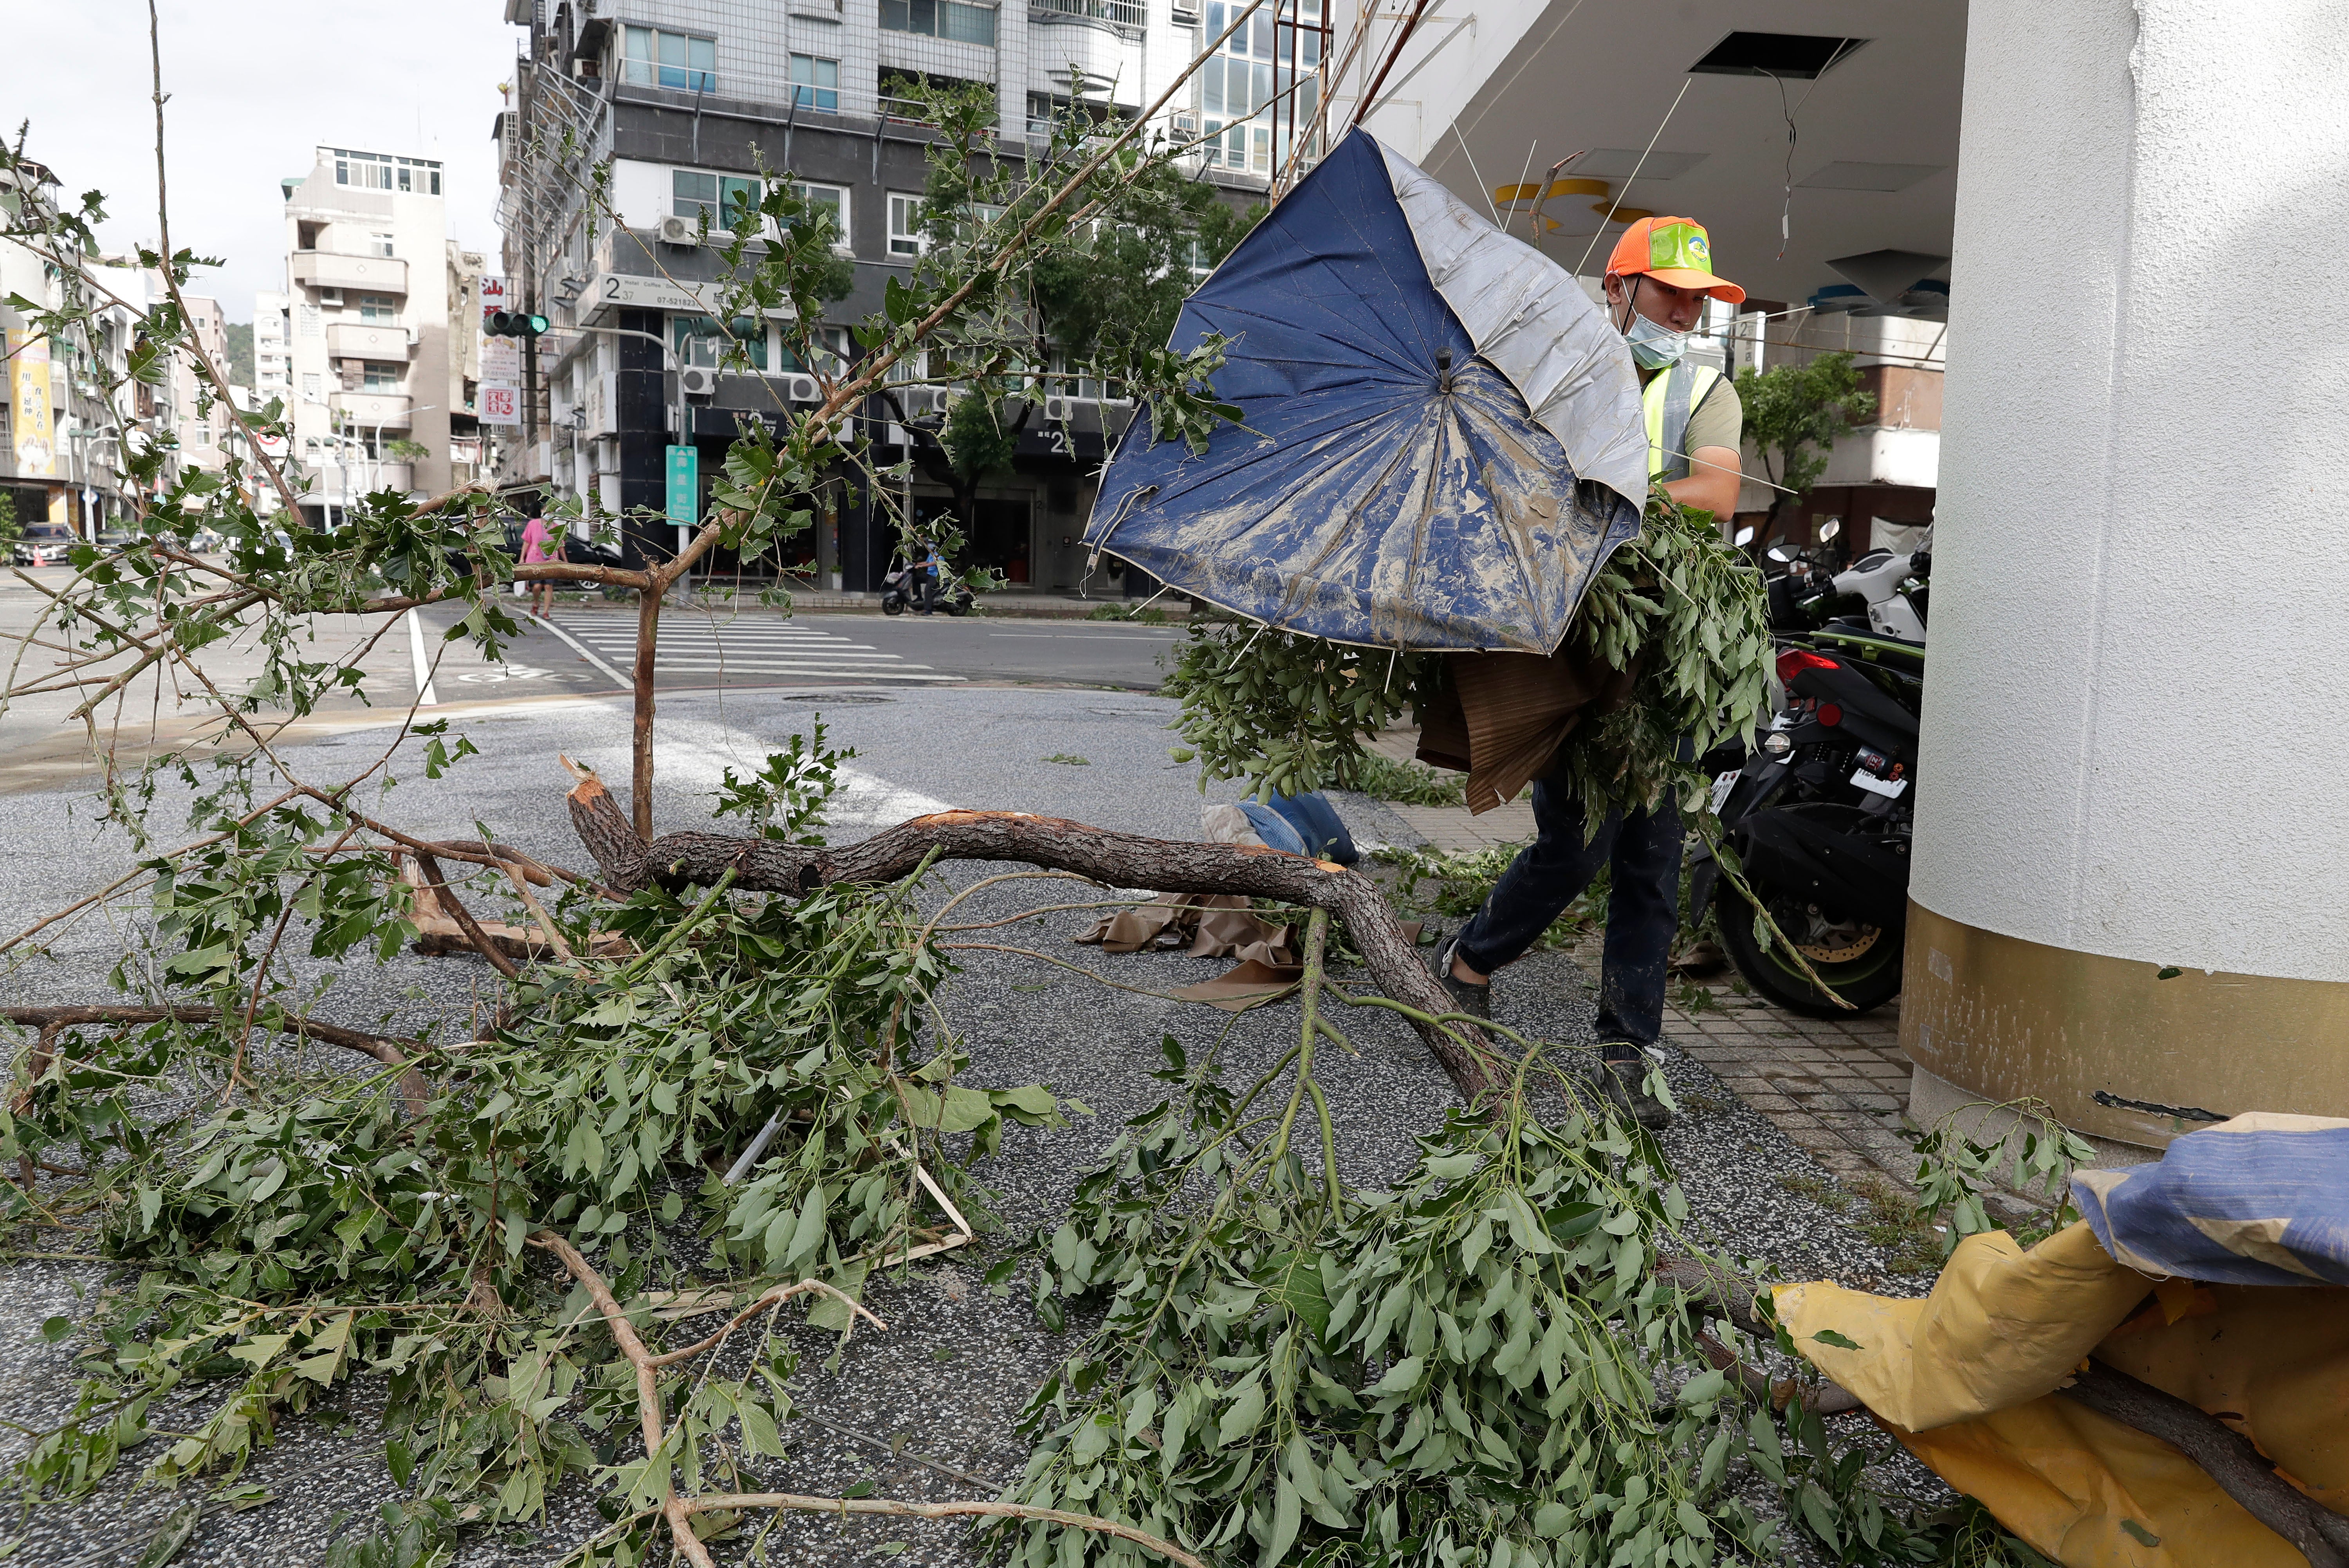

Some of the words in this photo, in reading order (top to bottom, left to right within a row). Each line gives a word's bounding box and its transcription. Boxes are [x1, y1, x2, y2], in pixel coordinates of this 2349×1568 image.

[606, 278, 620, 299] 2
[622, 291, 634, 301] 37
[657, 297, 699, 307] 07-521823
[1740, 322, 1747, 336] 2
[1051, 431, 1064, 453] 2
